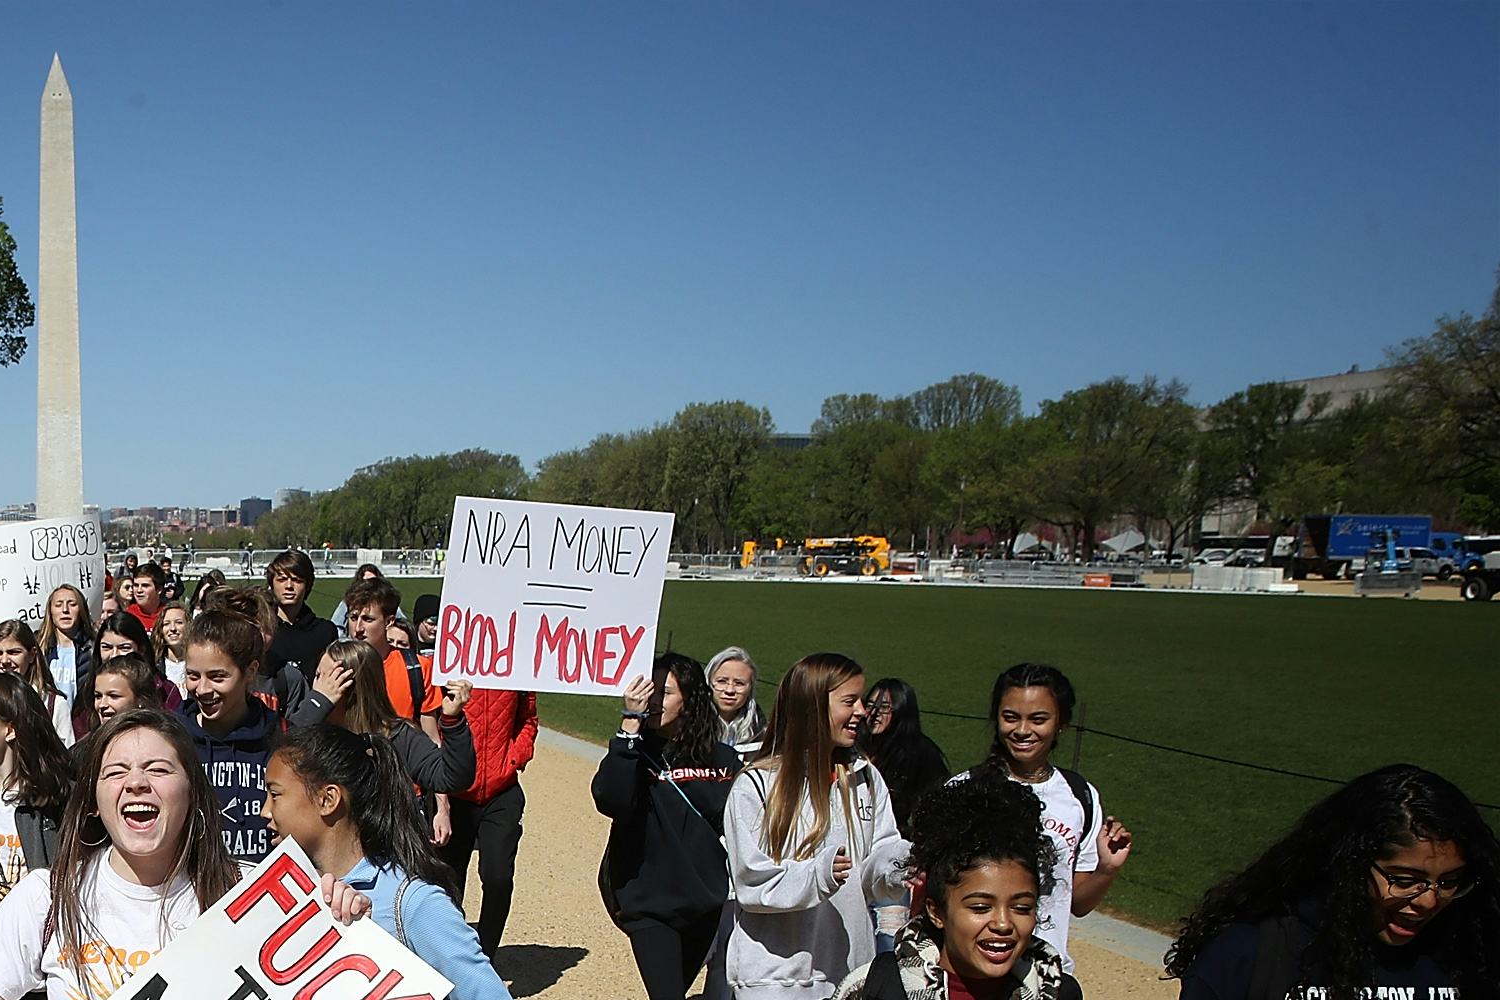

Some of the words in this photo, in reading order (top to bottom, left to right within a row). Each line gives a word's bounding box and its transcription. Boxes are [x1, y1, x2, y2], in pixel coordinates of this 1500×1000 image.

[30, 521, 98, 561] PEACE
[462, 509, 531, 568] NRA
[549, 516, 659, 578] MONEY
[534, 613, 645, 686] MONEY
